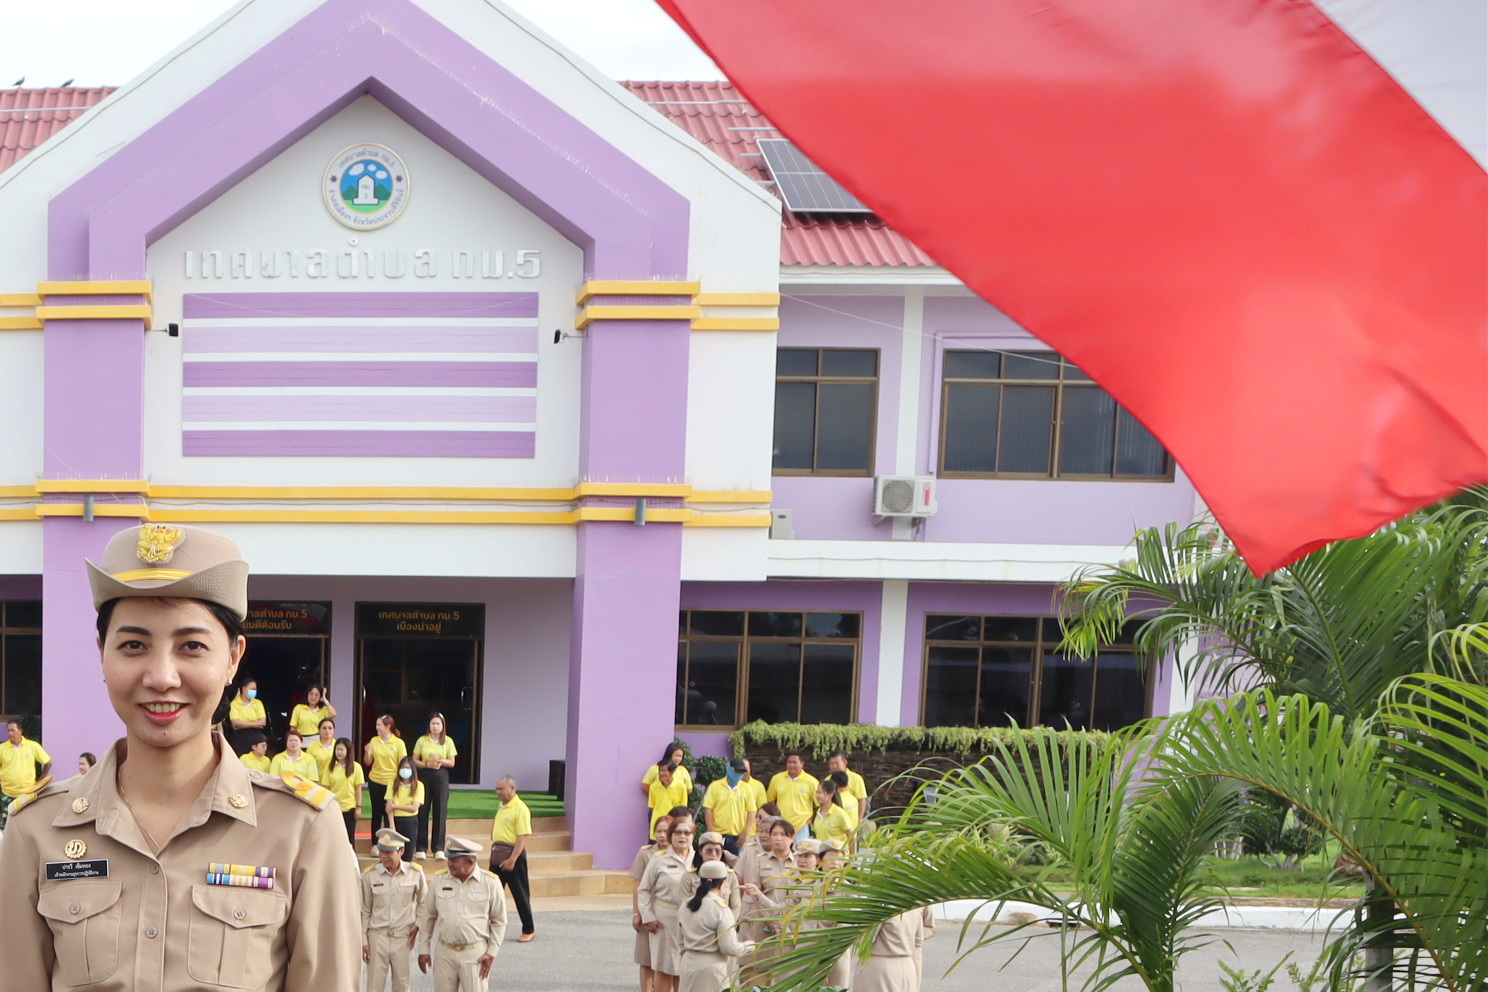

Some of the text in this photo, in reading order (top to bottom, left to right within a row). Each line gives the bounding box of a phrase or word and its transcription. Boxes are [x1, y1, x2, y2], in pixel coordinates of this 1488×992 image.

[184, 237, 542, 280] เทศบาลตำบล กม.5
[378, 609, 436, 620] เทศบาลตำบล
[396, 620, 443, 634] เมืองน่าอยู่
